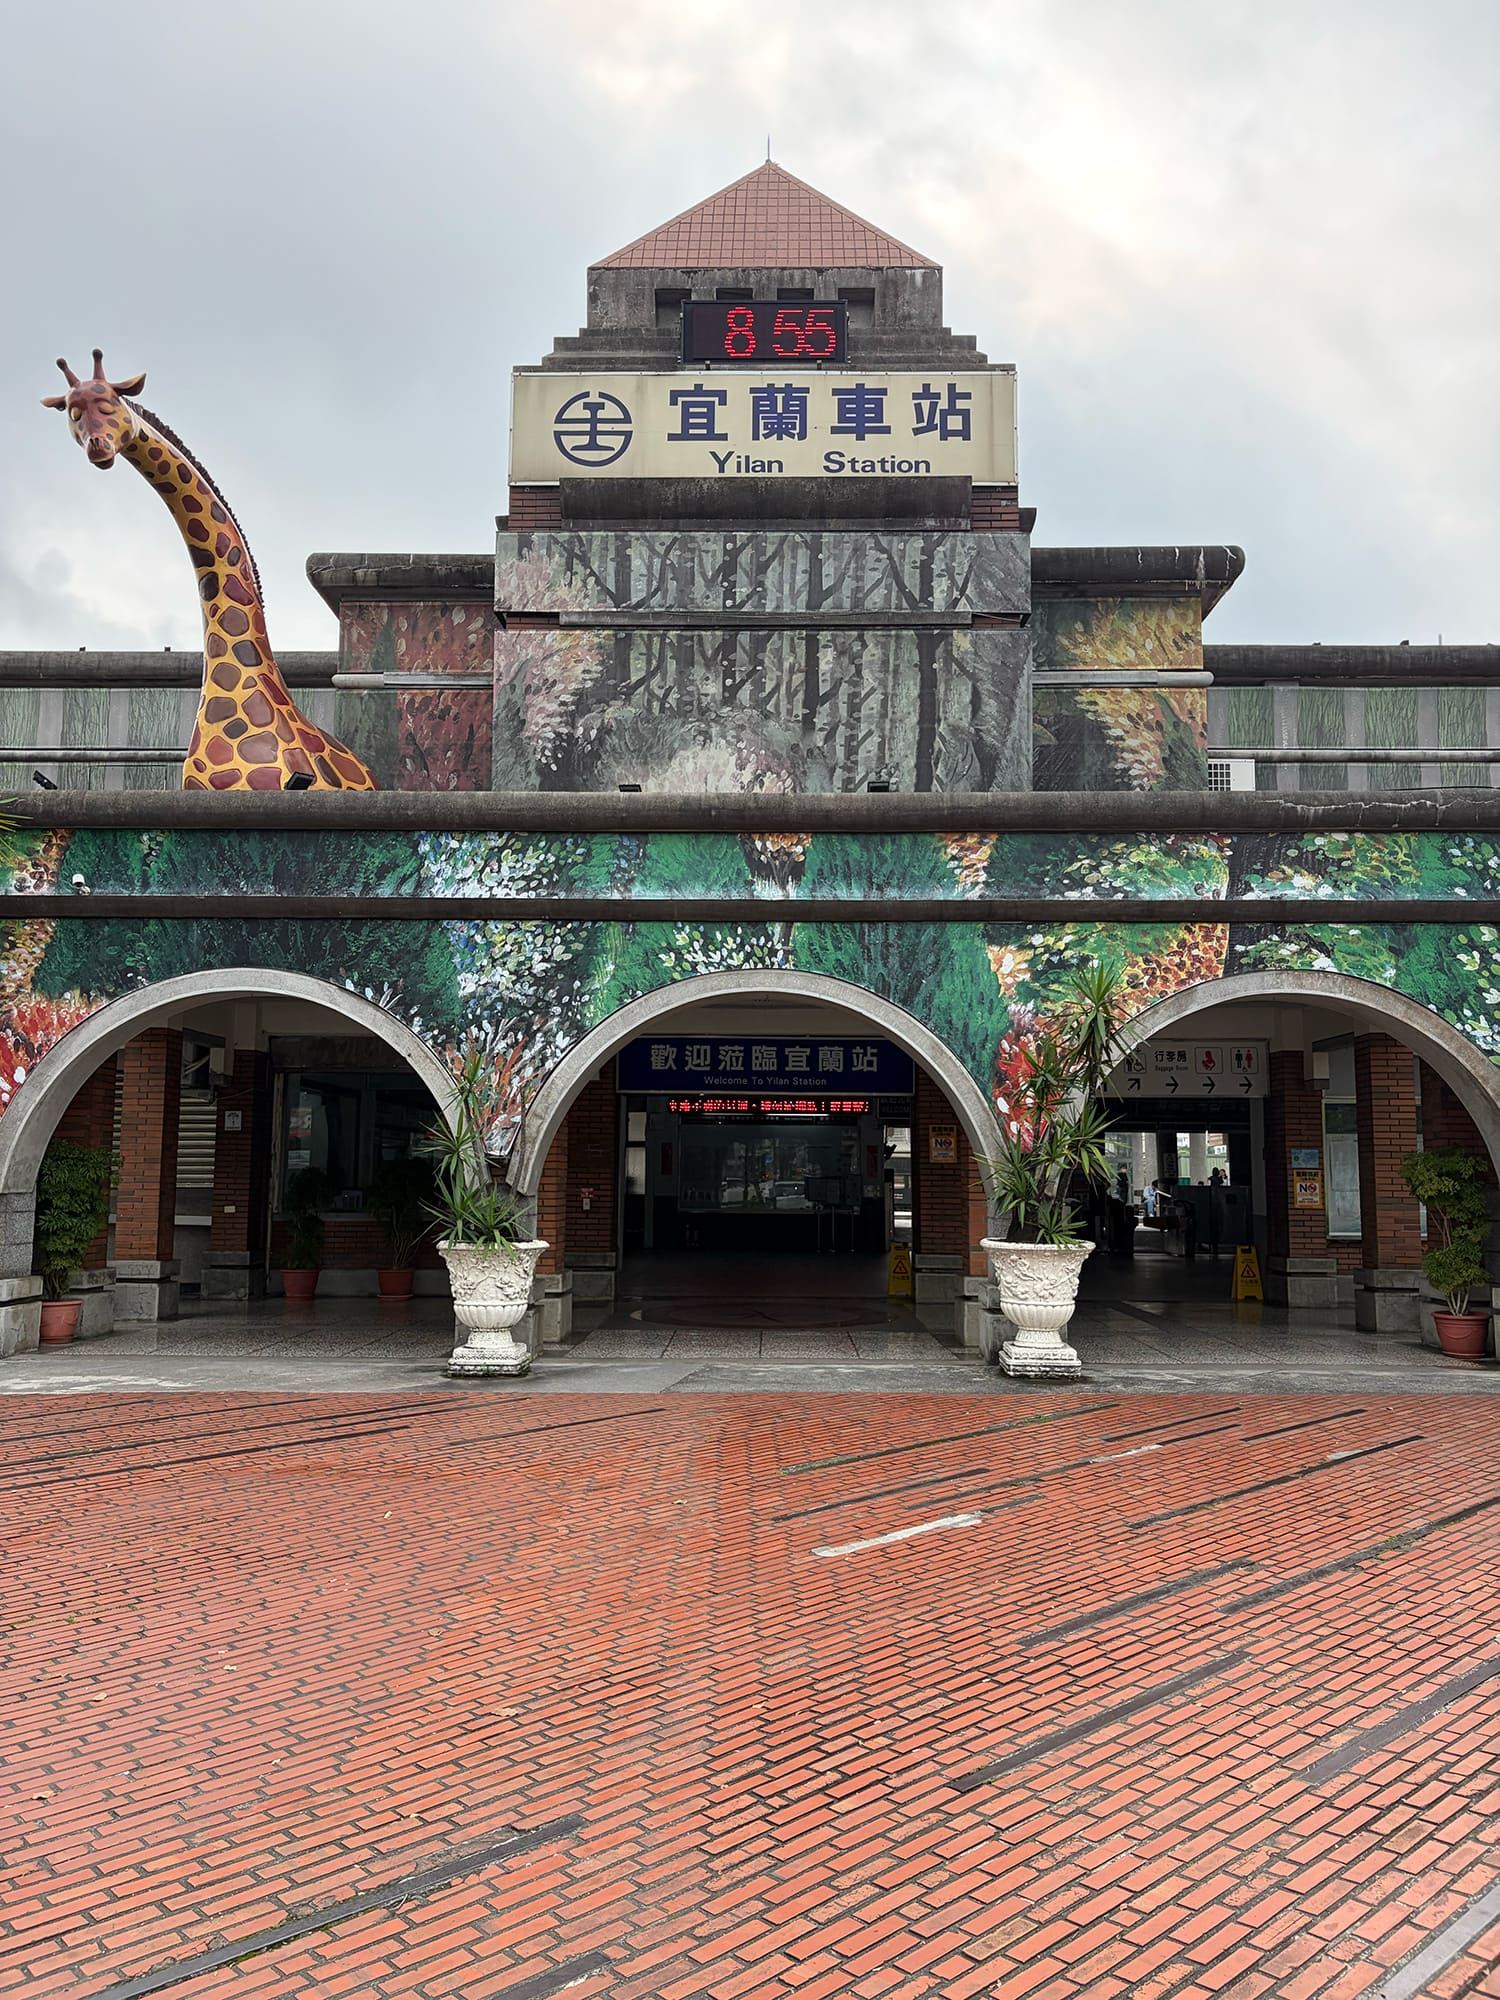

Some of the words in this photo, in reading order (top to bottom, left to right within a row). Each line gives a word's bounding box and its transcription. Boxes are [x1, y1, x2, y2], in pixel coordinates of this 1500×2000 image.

[725, 306, 757, 357] 8
[772, 309, 836, 356] 55
[667, 383, 972, 442] 宜蘭車站
[709, 451, 784, 473] Yilan
[823, 451, 931, 473] Station
[651, 1045, 877, 1072] 歡迎蒞臨宜蘭站
[1154, 1050, 1187, 1062] 行李房
[704, 1076, 748, 1086] Welcome
[752, 1076, 764, 1086] To
[766, 1076, 790, 1086] Yilan
[792, 1076, 827, 1086] Station
